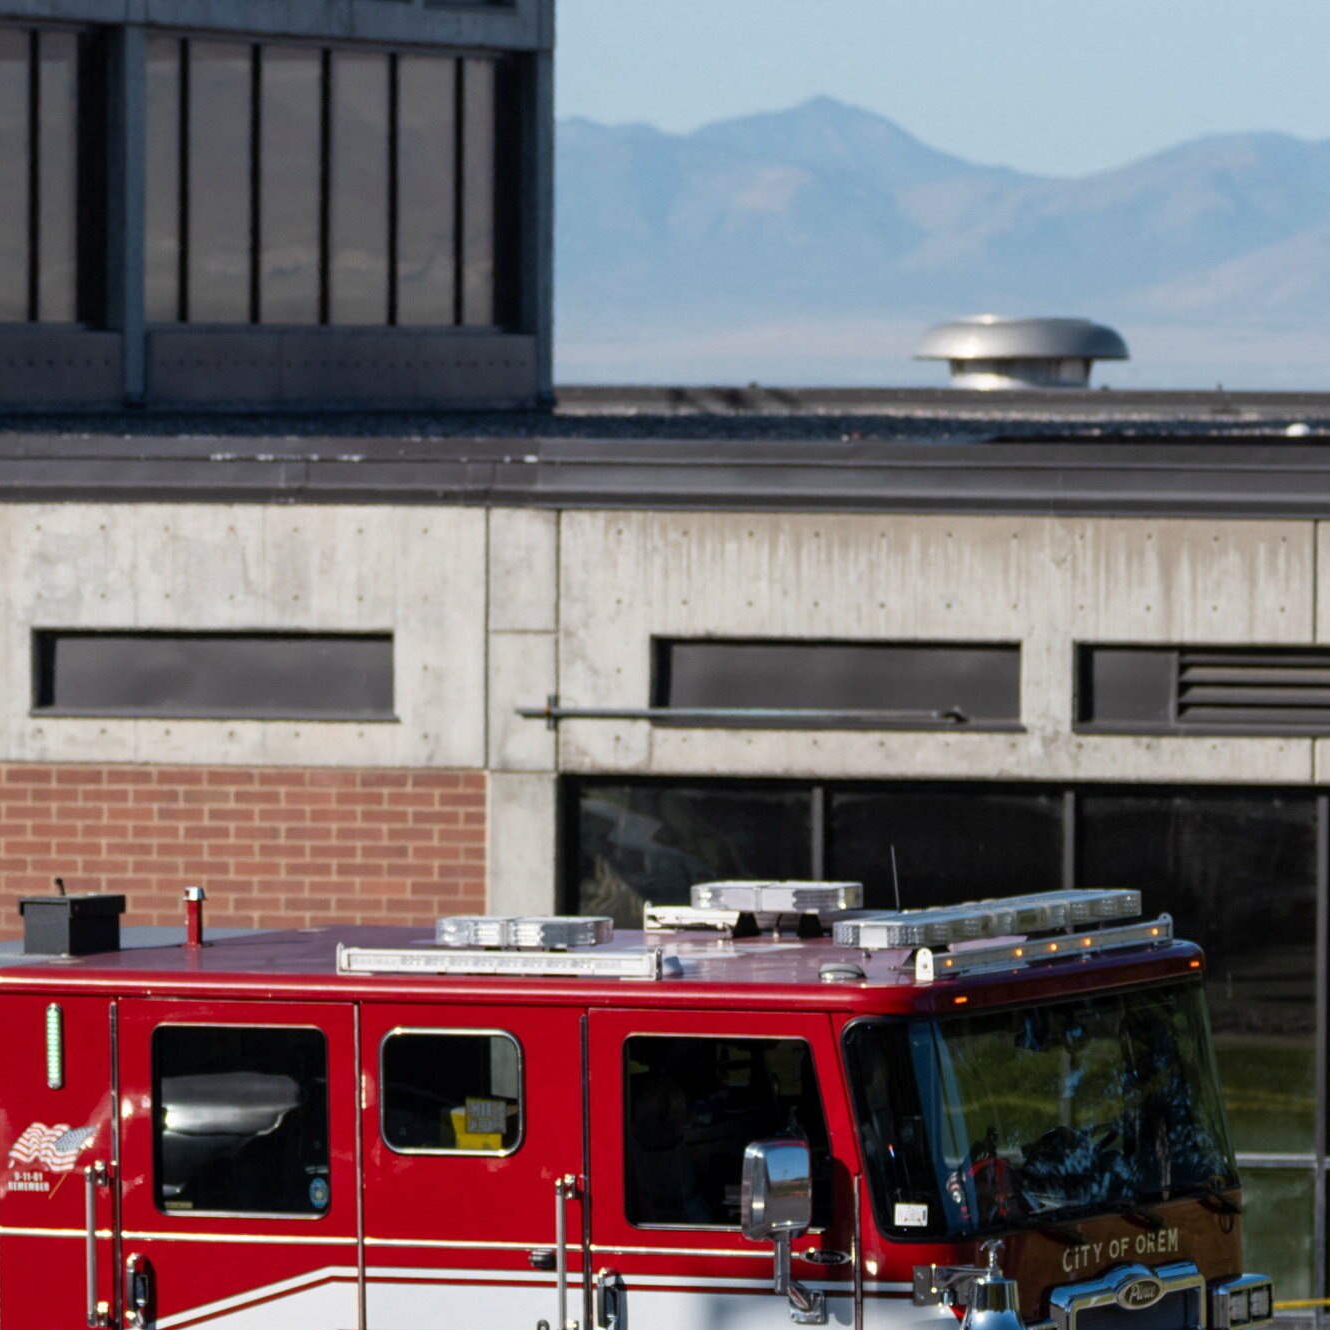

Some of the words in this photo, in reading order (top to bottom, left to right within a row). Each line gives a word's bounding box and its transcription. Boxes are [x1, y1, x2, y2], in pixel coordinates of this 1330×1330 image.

[7, 1181, 51, 1192] REMEMBER
[1062, 1242, 1103, 1273] CITY
[1108, 1237, 1130, 1259] OF
[1134, 1228, 1179, 1255] OREM
